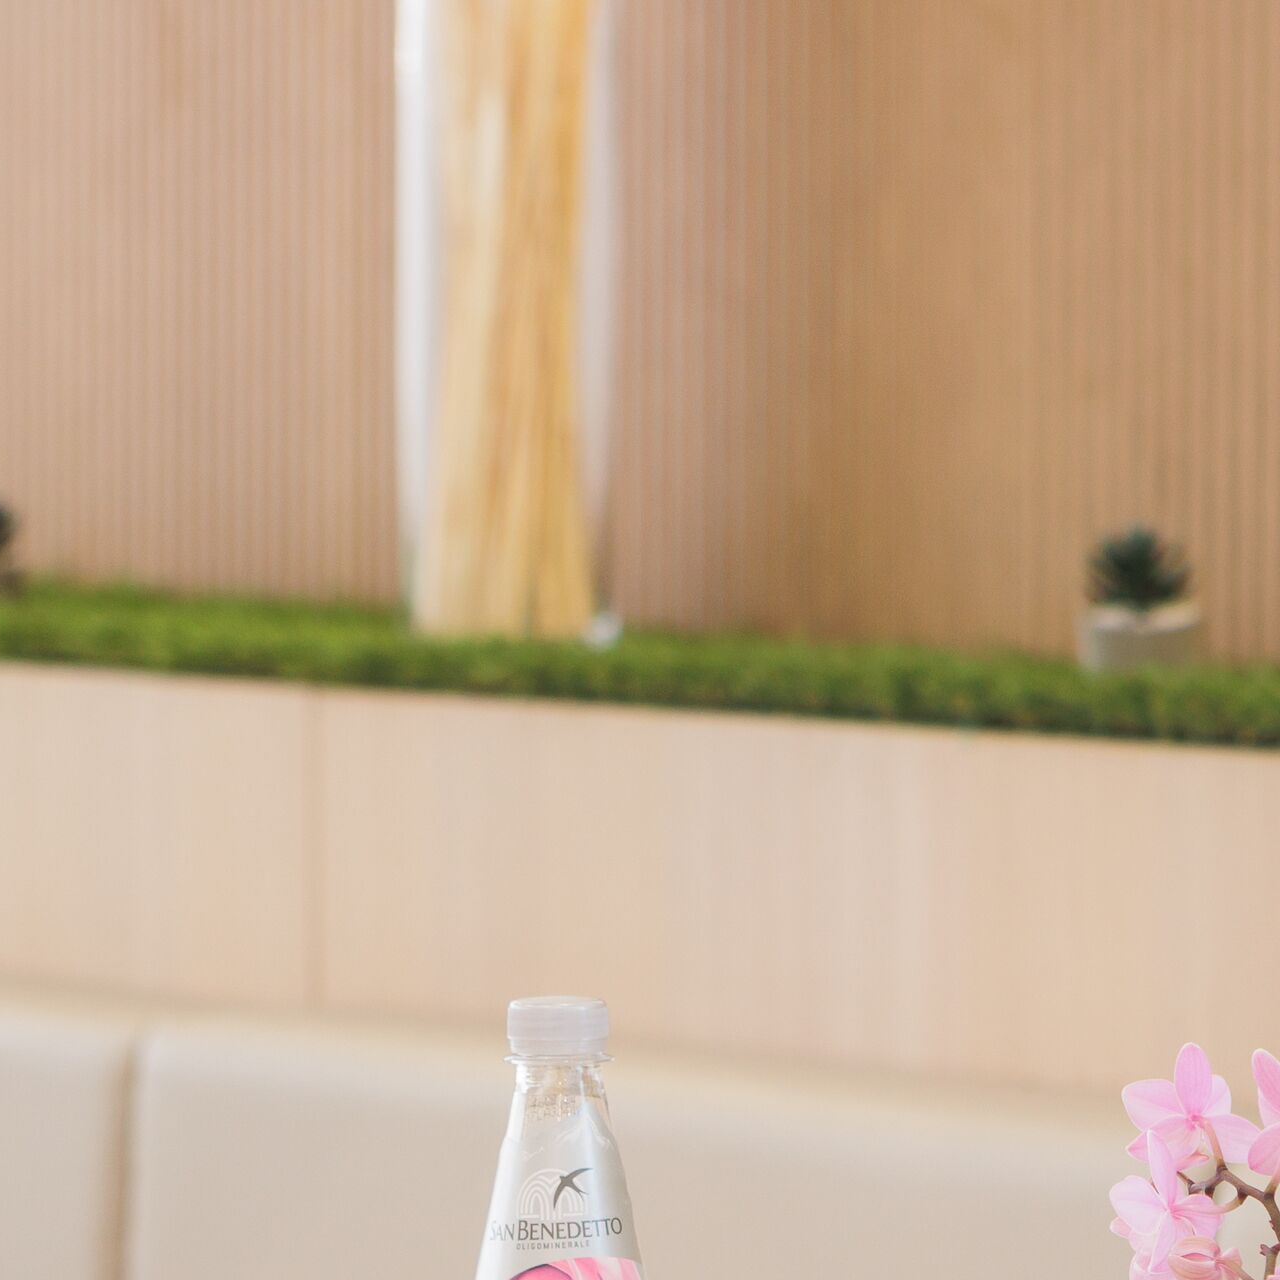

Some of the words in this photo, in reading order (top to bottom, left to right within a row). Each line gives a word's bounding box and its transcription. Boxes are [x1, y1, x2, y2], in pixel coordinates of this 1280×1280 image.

[489, 1219, 515, 1242] SAN
[517, 1217, 623, 1241] BENEDETTO
[516, 1240, 591, 1251] OLIGOMINERALE
